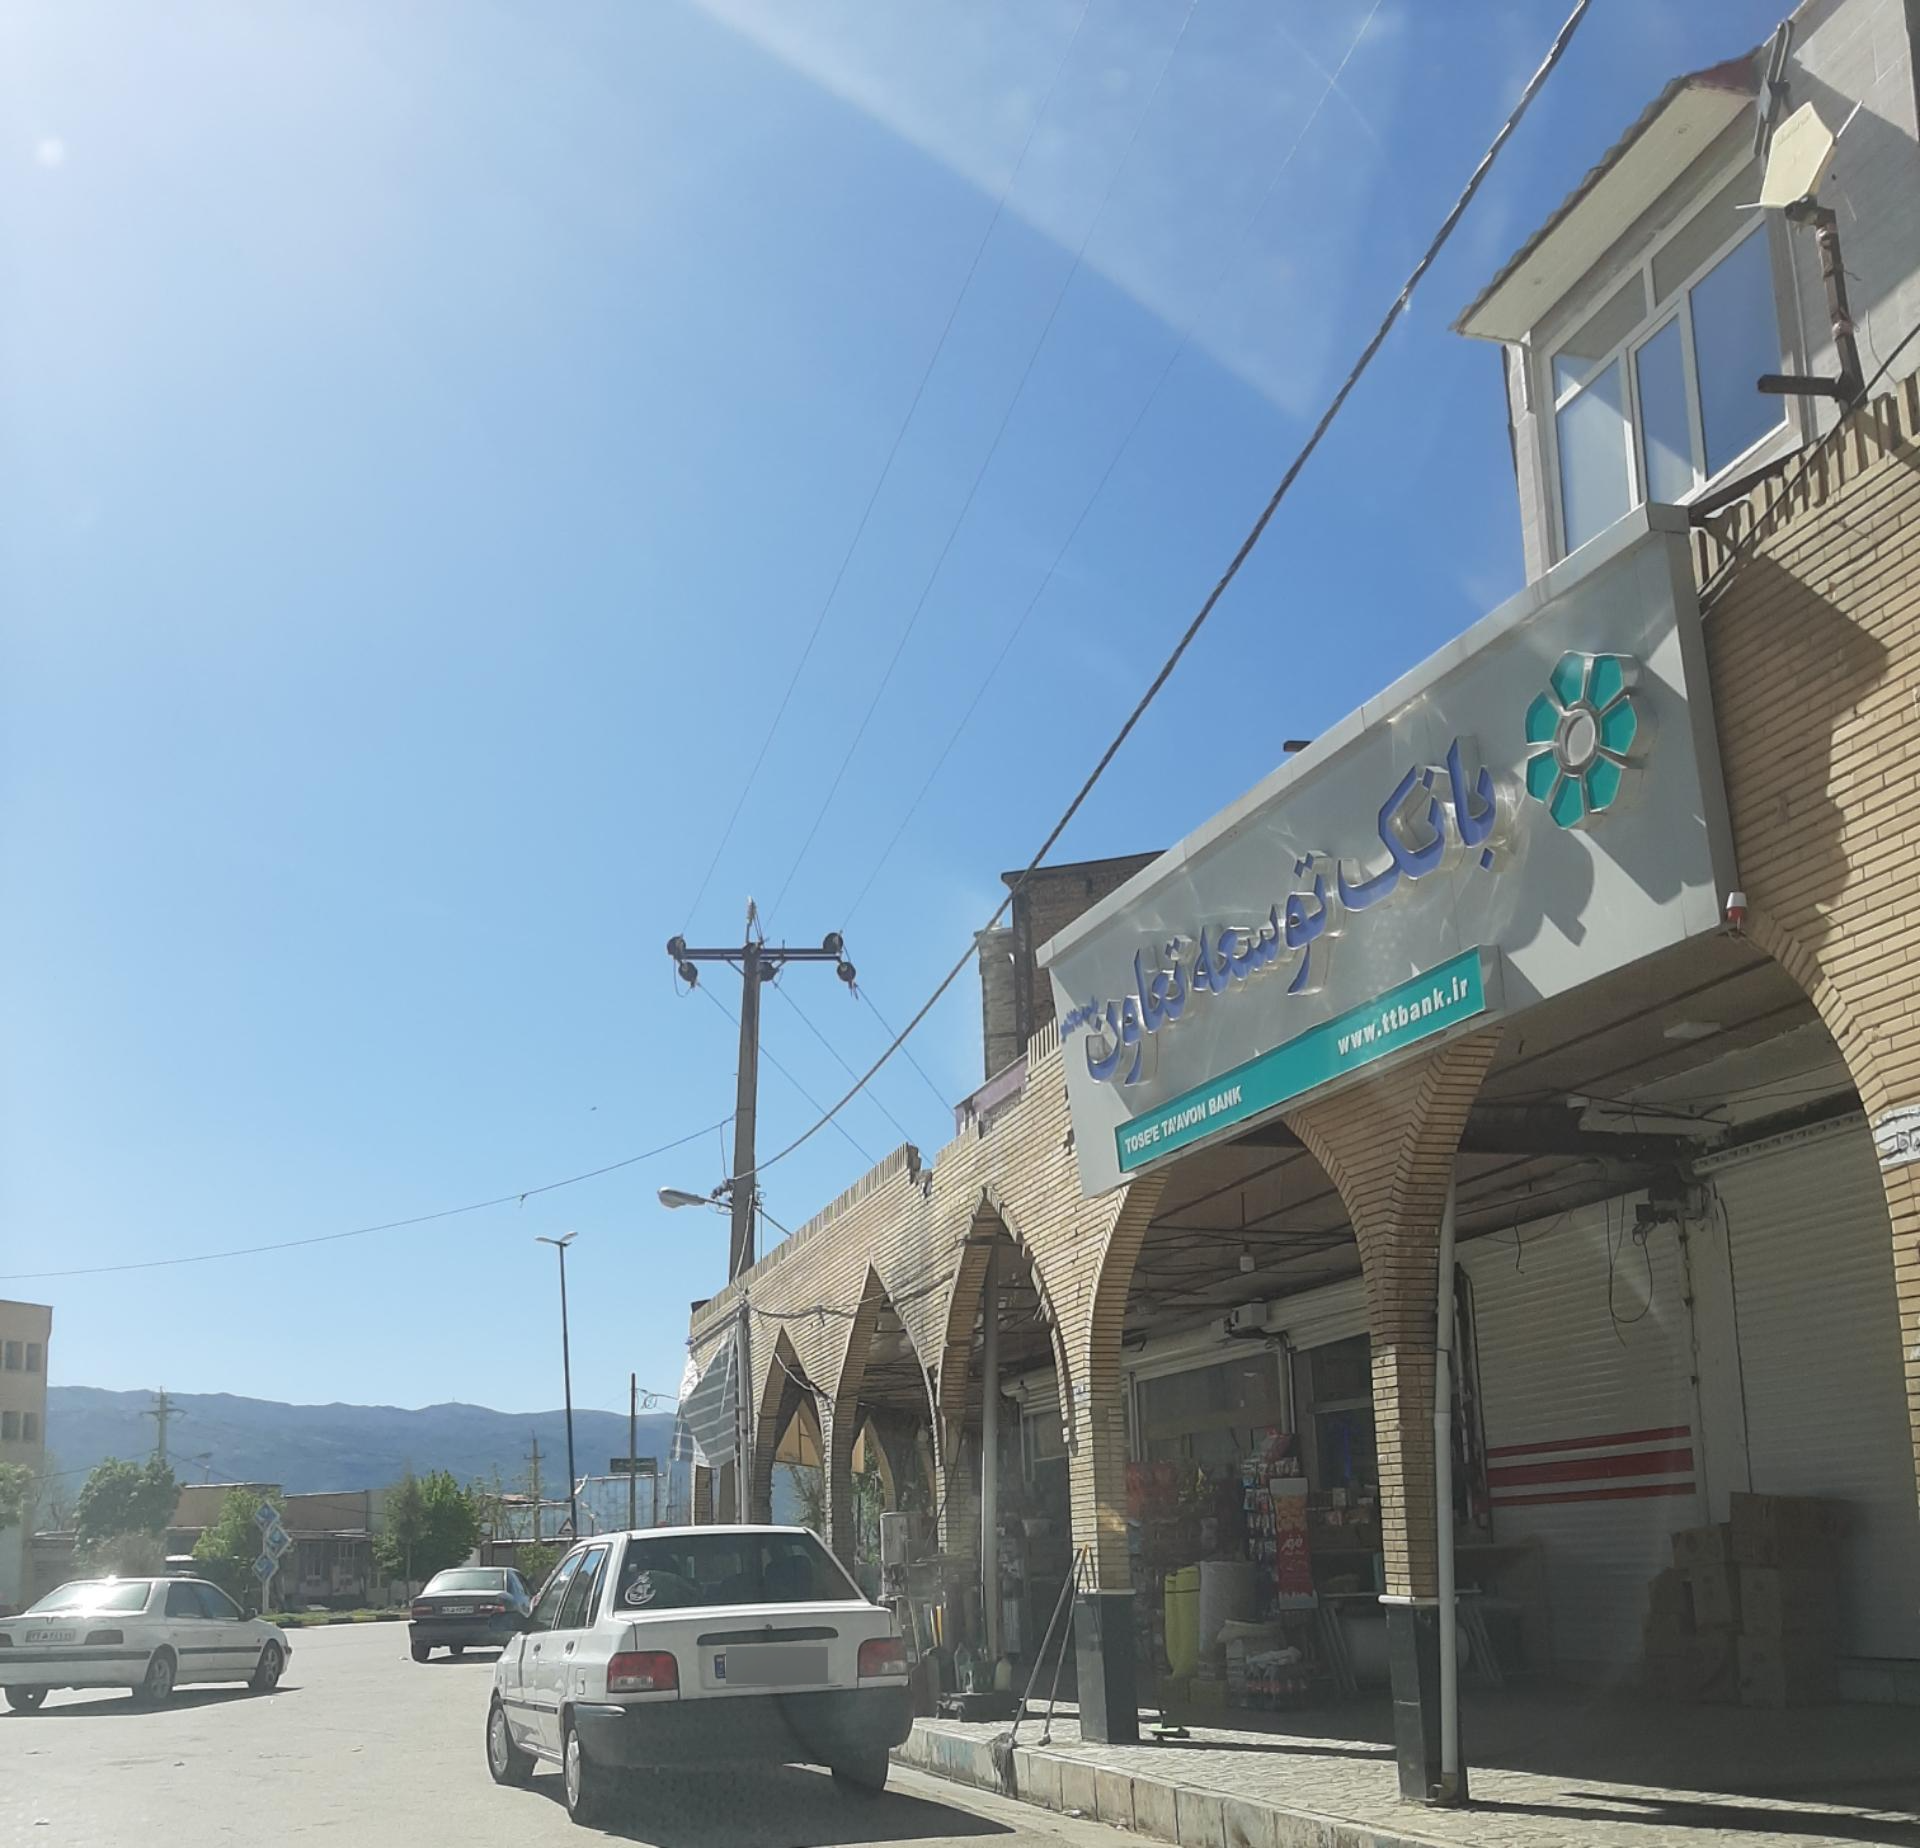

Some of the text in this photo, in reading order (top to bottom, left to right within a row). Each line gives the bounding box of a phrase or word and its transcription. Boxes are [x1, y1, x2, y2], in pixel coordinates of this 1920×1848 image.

[1085, 736, 1497, 1088] بانک توسعه تعاون
[1337, 976, 1468, 1055] www.ttbank.ir
[1124, 1085, 1243, 1154] TOSE'E TA'AVON BANK
